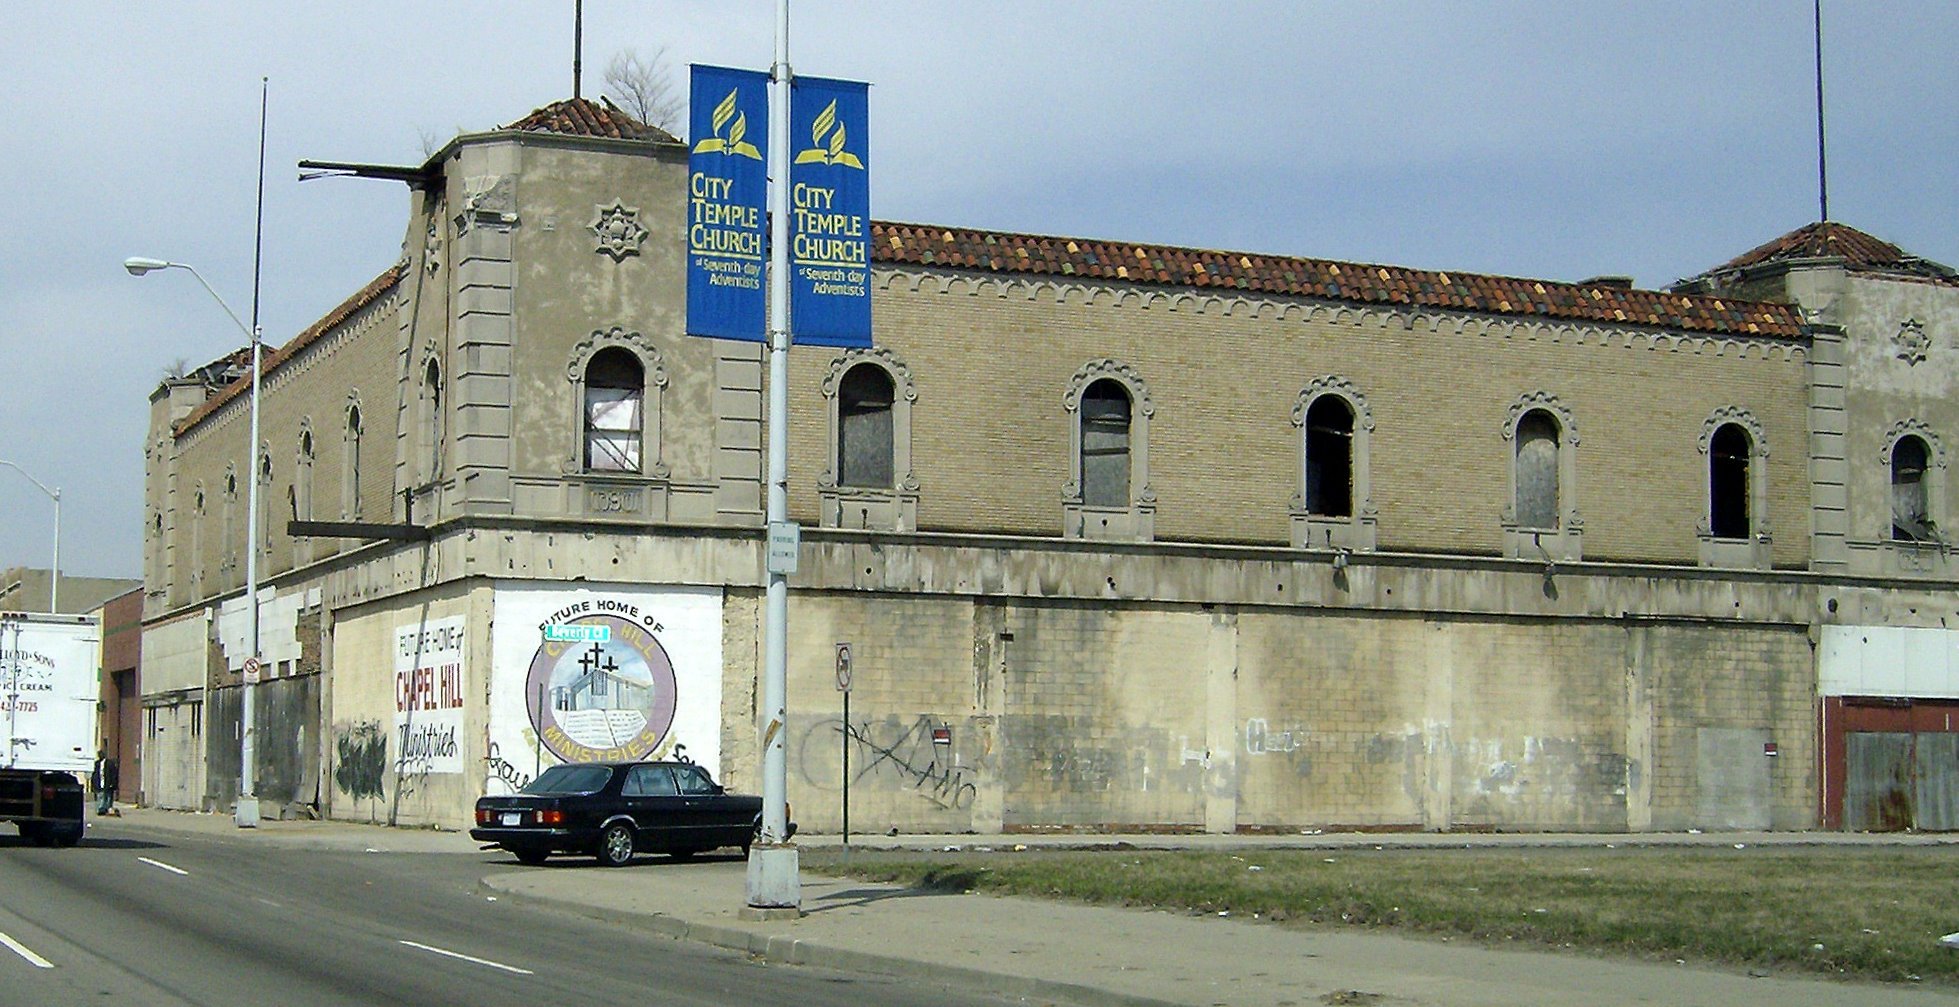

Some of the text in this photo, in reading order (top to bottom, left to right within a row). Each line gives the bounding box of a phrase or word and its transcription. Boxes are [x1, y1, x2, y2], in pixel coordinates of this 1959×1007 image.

[692, 198, 758, 228] TEMPLE
[794, 208, 862, 237] TEMPLE
[691, 224, 761, 254] CHURCH
[794, 233, 865, 262] CHURCH
[709, 273, 760, 289] Adventists
[813, 282, 865, 297] Adventists
[597, 600, 639, 618] HOME
[643, 615, 665, 633] OF
[433, 627, 455, 653] HOME
[20, 683, 53, 692] CREAM
[396, 663, 463, 713] CHAPEL HILL
[399, 722, 458, 759] Ministries
[544, 727, 656, 763] MINISTRIES
